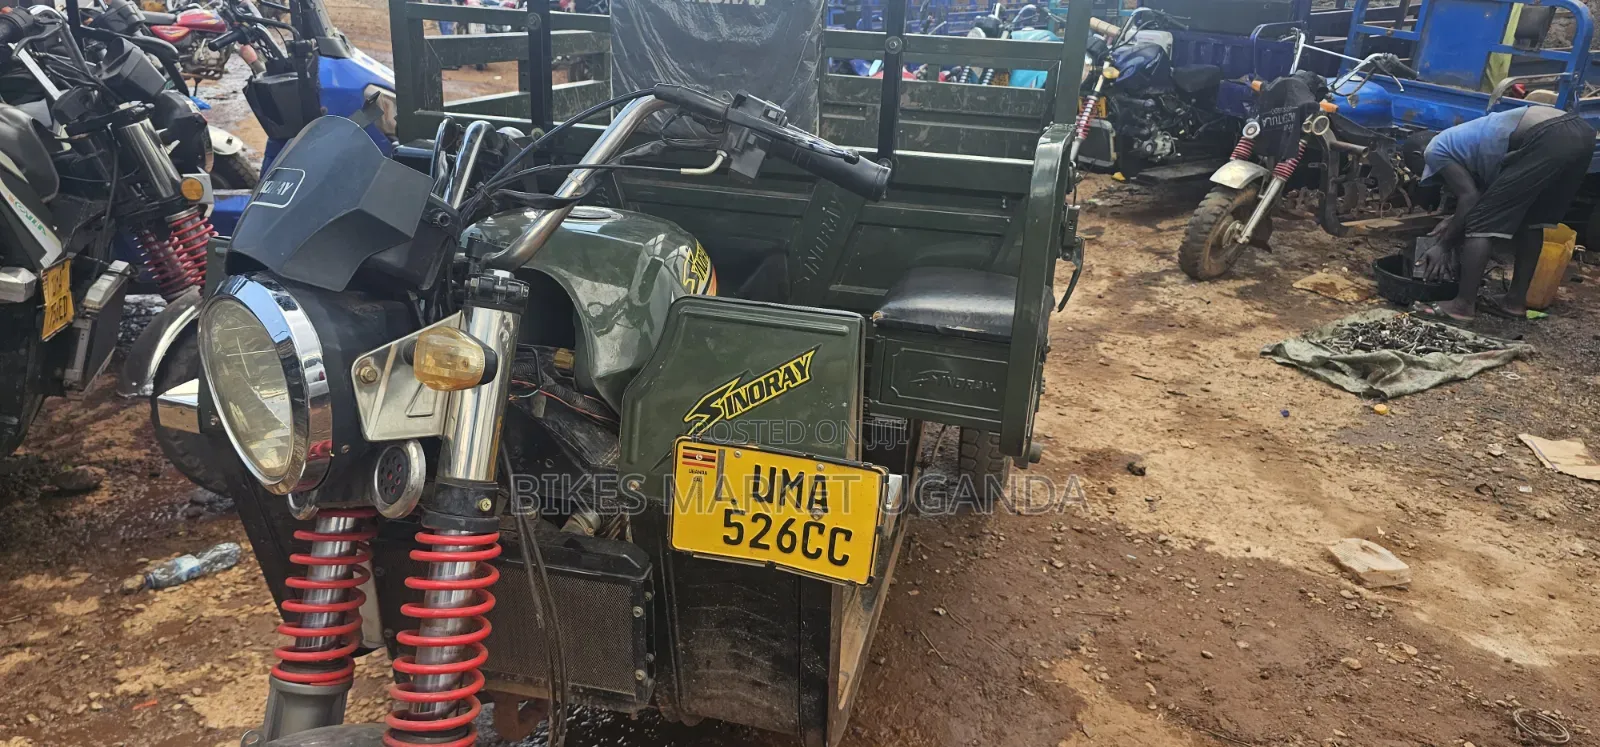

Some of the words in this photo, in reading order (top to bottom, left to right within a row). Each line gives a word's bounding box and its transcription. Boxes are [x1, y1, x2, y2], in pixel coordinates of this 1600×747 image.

[683, 348, 816, 436] SINORAY
[752, 464, 829, 514] UMA
[723, 508, 853, 566] 526CC
